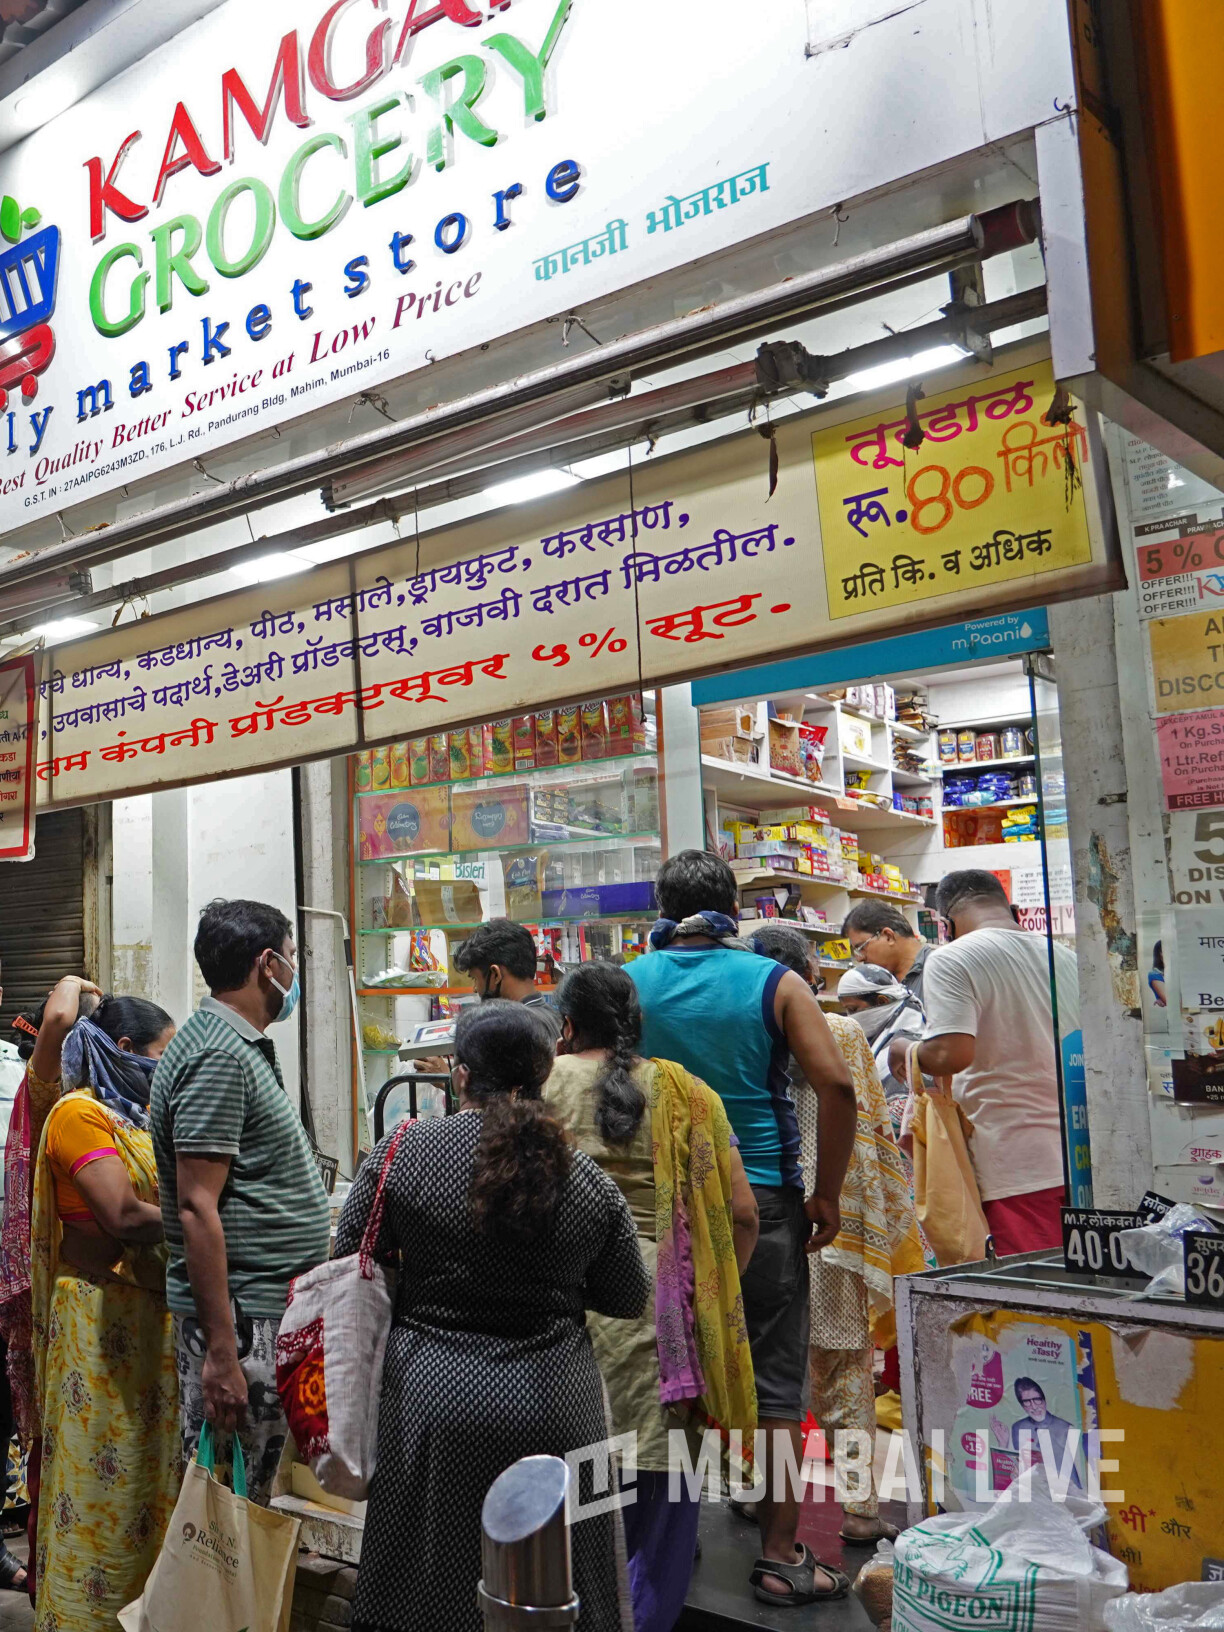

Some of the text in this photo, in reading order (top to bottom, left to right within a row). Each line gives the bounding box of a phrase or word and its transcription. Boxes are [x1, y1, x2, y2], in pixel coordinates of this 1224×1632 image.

[83, 0, 514, 245] KAMGA
[88, 0, 575, 338] GROCERY
[532, 161, 770, 284] कानजी भोजराज
[76, 277, 314, 424] market
[343, 158, 585, 299] store
[34, 438, 104, 486] Quality
[111, 409, 172, 449] Better
[180, 363, 264, 420] Service
[271, 349, 295, 381] at
[308, 316, 376, 366] Low
[390, 270, 482, 331] Price
[24, 491, 46, 508] G.S.T.
[48, 485, 57, 500] IN
[150, 441, 167, 456] 176,
[208, 401, 260, 434] Pandurang
[261, 386, 288, 415] Bldg,
[290, 373, 327, 405] Mahim,
[330, 348, 390, 384] Mumbai-16
[842, 529, 1053, 601] प्रति कि. व अधिक
[1146, 548, 1163, 574] 5
[1172, 541, 1203, 570] %
[1141, 573, 1193, 590] OFFER!!!
[1143, 585, 1195, 602] OFFER!!!
[71, 656, 130, 690] धान्य,
[136, 627, 244, 672] कडधान्य,
[250, 609, 305, 641] पीठ,
[540, 500, 691, 560] फरसाण,
[1144, 597, 1197, 614] OFFER!!!
[52, 685, 147, 733] उपवासाचे
[420, 587, 523, 638] वाजवी
[530, 568, 612, 613] दरात
[620, 522, 796, 589] मिळतील.
[965, 615, 1019, 632] Powered by
[952, 626, 1020, 650] m.Paani
[100, 719, 218, 763] कंपनी
[644, 591, 792, 644] सूट.
[1184, 722, 1224, 739] Kg.S
[1179, 741, 1192, 749] On
[1174, 767, 1188, 776] On
[1176, 792, 1210, 806] FREE
[455, 860, 485, 880] Bisleri
[1176, 889, 1212, 905] ON
[1027, 1337, 1063, 1351] Healthy
[1160, 1518, 1192, 1539] और
[917, 1574, 1005, 1620] PIGEON
